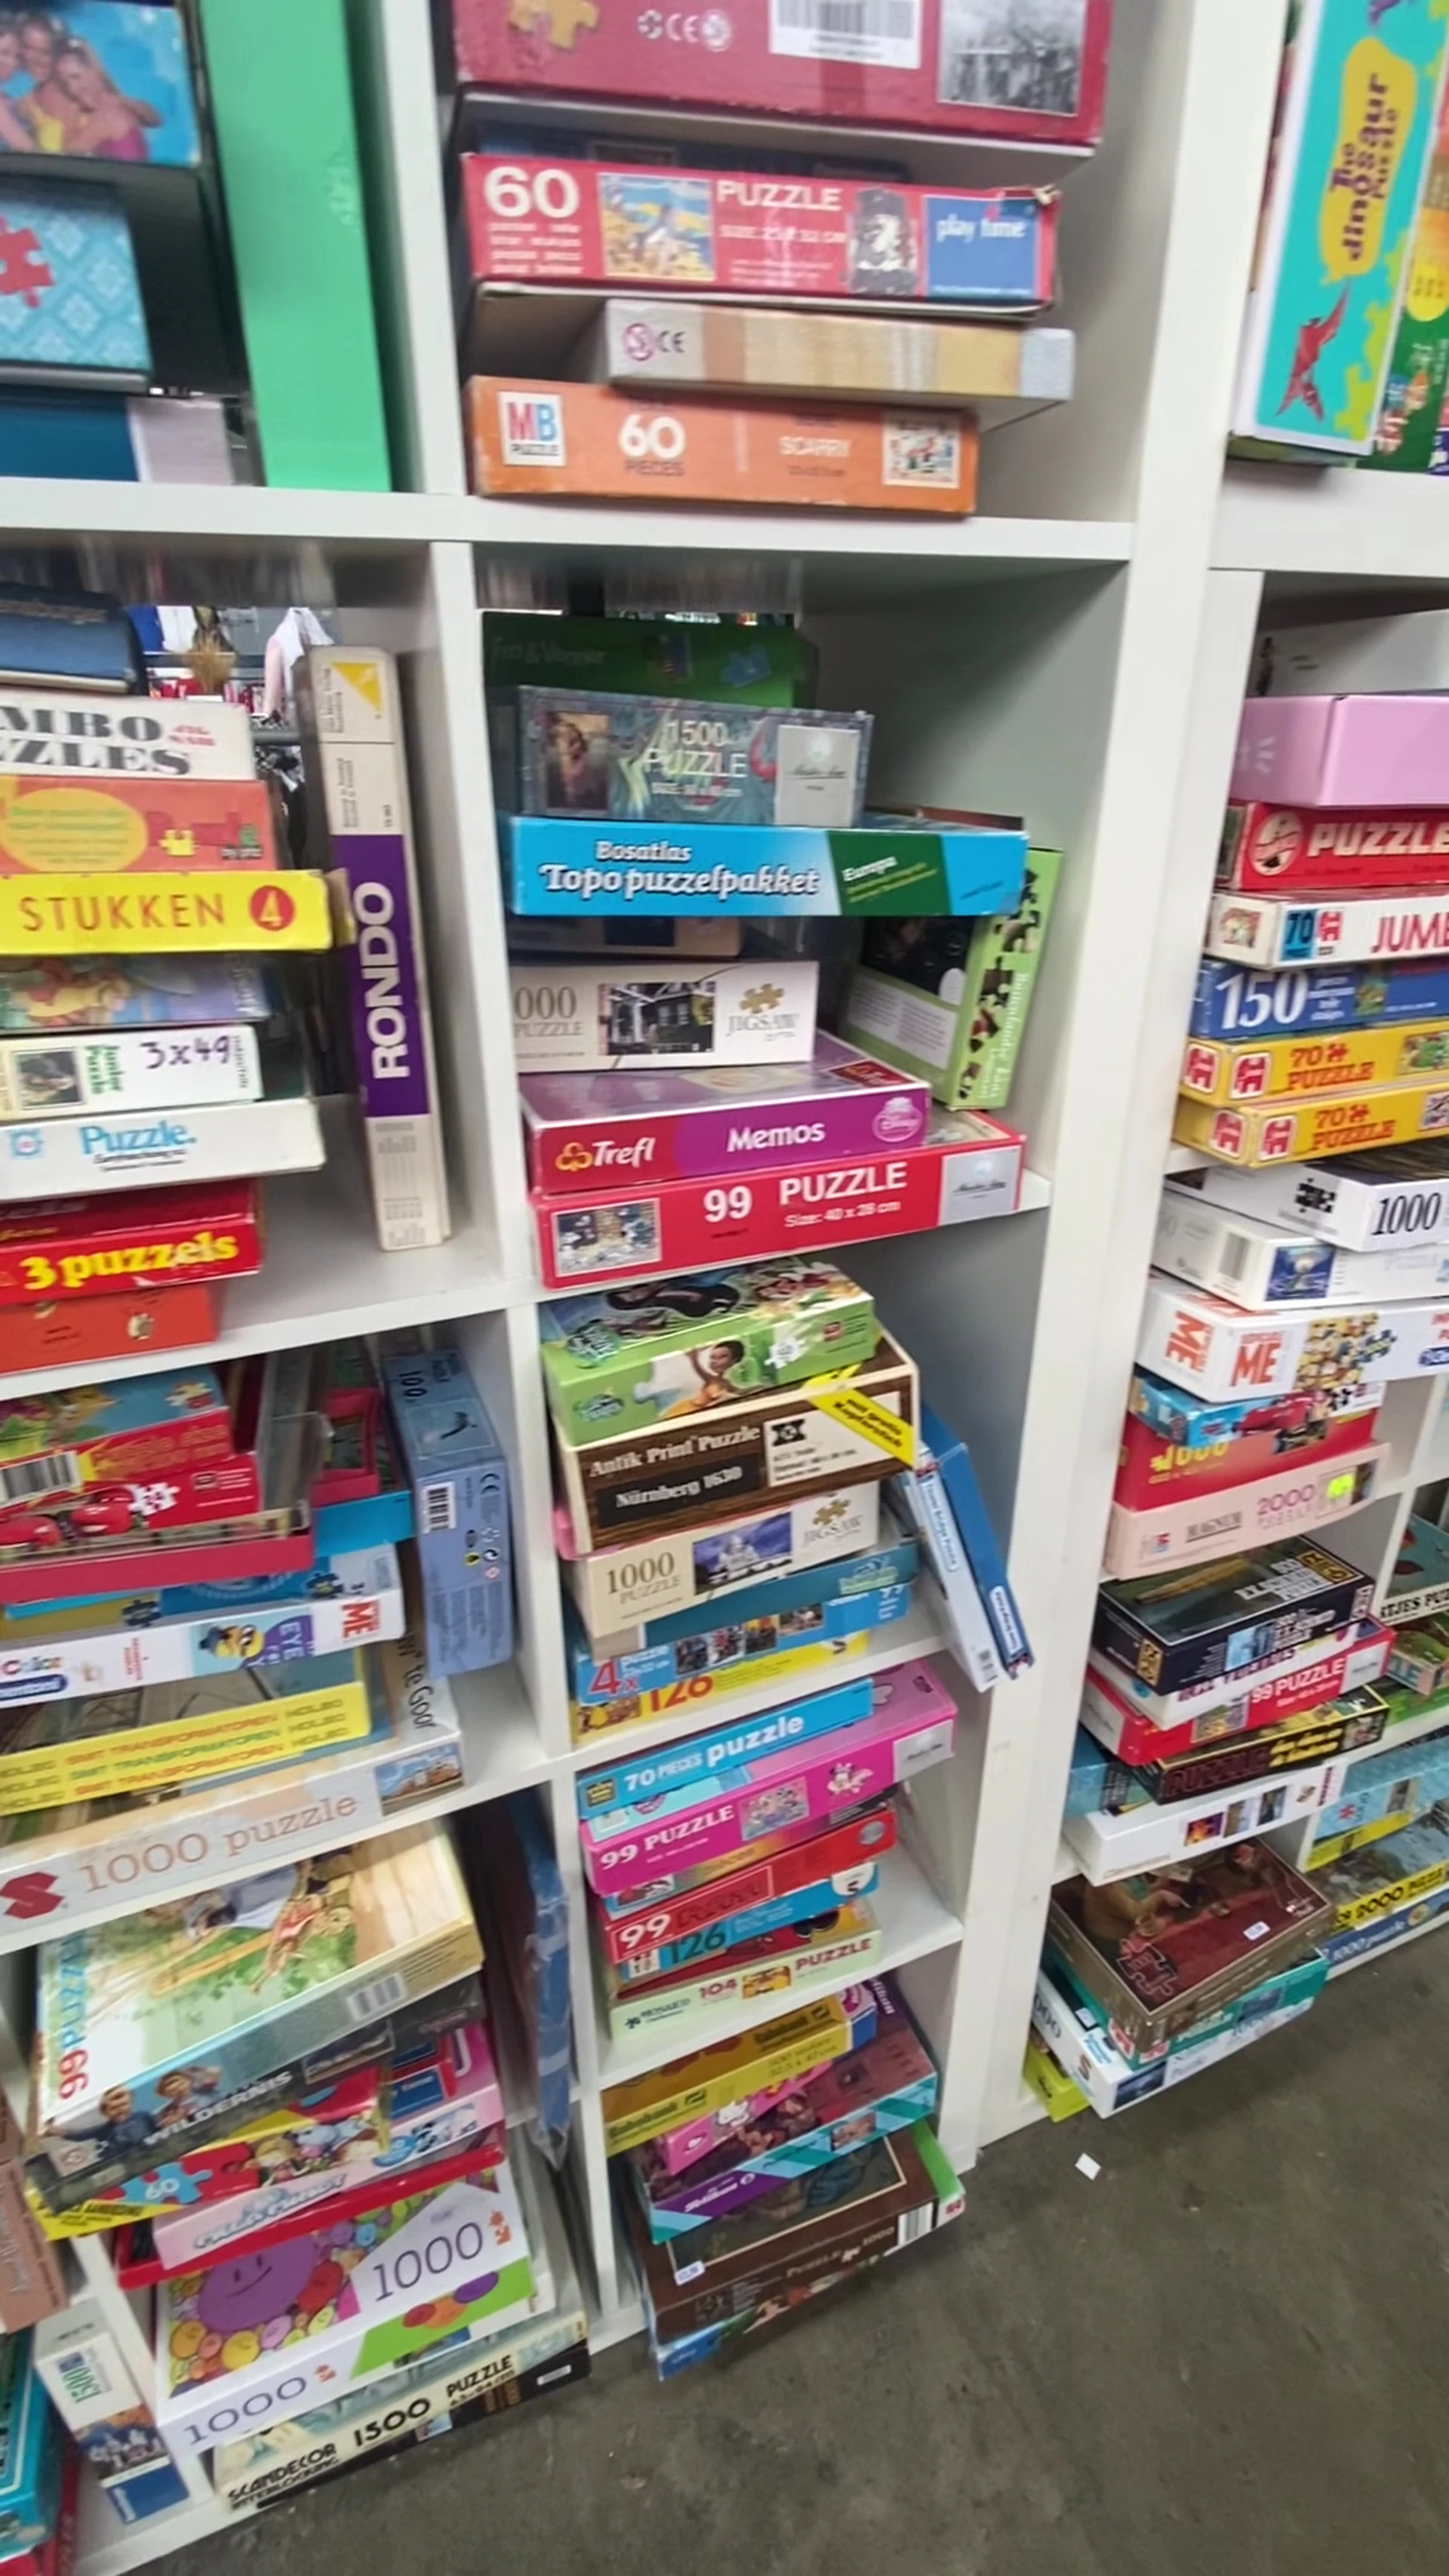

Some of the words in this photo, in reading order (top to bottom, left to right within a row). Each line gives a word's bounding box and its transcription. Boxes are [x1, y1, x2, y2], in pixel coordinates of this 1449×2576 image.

[1341, 73, 1389, 261] dinosaur
[484, 166, 580, 218] 60
[717, 180, 843, 211] PUZZLE
[658, 331, 686, 353] CE
[506, 402, 558, 441] MB
[618, 414, 686, 459] 60
[666, 719, 731, 748] 1500
[0, 738, 191, 776] ZLES
[645, 747, 747, 778] PUZZLE
[595, 840, 694, 863] Bosatlas
[842, 855, 898, 882] Europa
[538, 863, 620, 901] Topo
[623, 863, 821, 901] puzzelpakket
[19, 893, 226, 932] STUKKEN
[258, 889, 285, 928] 4
[353, 882, 411, 1079] RONDO
[1216, 971, 1310, 1029] 150
[513, 986, 577, 1020] 000
[1287, 1061, 1376, 1091] PUZZLE
[1291, 1047, 1322, 1067] 70
[1311, 1120, 1397, 1149] PUZZLE
[1315, 1107, 1347, 1128] 70
[592, 1136, 657, 1168] Trefl
[726, 1122, 826, 1153] Memos
[703, 1185, 752, 1223] 99
[779, 1161, 908, 1208] PUZZLE
[1371, 1192, 1442, 1236] 1000
[20, 1255, 57, 1291] 3
[58, 1231, 240, 1288] puzzels
[398, 1370, 428, 1399] 100
[1229, 1342, 1282, 1387] ME
[589, 1451, 643, 1478] Antik
[646, 1437, 695, 1464] Print
[698, 1424, 761, 1454] Puzzle
[615, 1476, 701, 1509] Nürnberg
[703, 1465, 743, 1489] 1630
[1257, 1484, 1316, 1516] 2000
[606, 1551, 675, 1595] 1000
[341, 1601, 374, 1640] ME
[650, 1674, 714, 1713] 126
[1251, 1683, 1275, 1704] 99
[1275, 1657, 1346, 1698] PUZZLE
[408, 1682, 438, 1730] Goor
[623, 1768, 658, 1791] 70
[658, 1753, 702, 1780] PIECES
[706, 1714, 804, 1768] puzzle
[80, 1832, 209, 1893] 1000
[223, 1793, 358, 1856] puzzle
[600, 1844, 638, 1869] 99
[644, 1804, 734, 1851] PUZZLE
[619, 1913, 672, 1950] 99
[669, 1924, 725, 1963] 126
[698, 1977, 737, 2000] 104
[795, 1937, 873, 1971] PUZZLE
[58, 2048, 90, 2100] 99
[143, 2070, 294, 2146] WILDERNIS
[372, 2221, 484, 2302] 1000
[182, 2375, 308, 2447] 1000
[228, 2442, 337, 2502] SCANDECOR
[352, 2396, 432, 2448] 1500
[445, 2354, 514, 2399] PUZZLE
